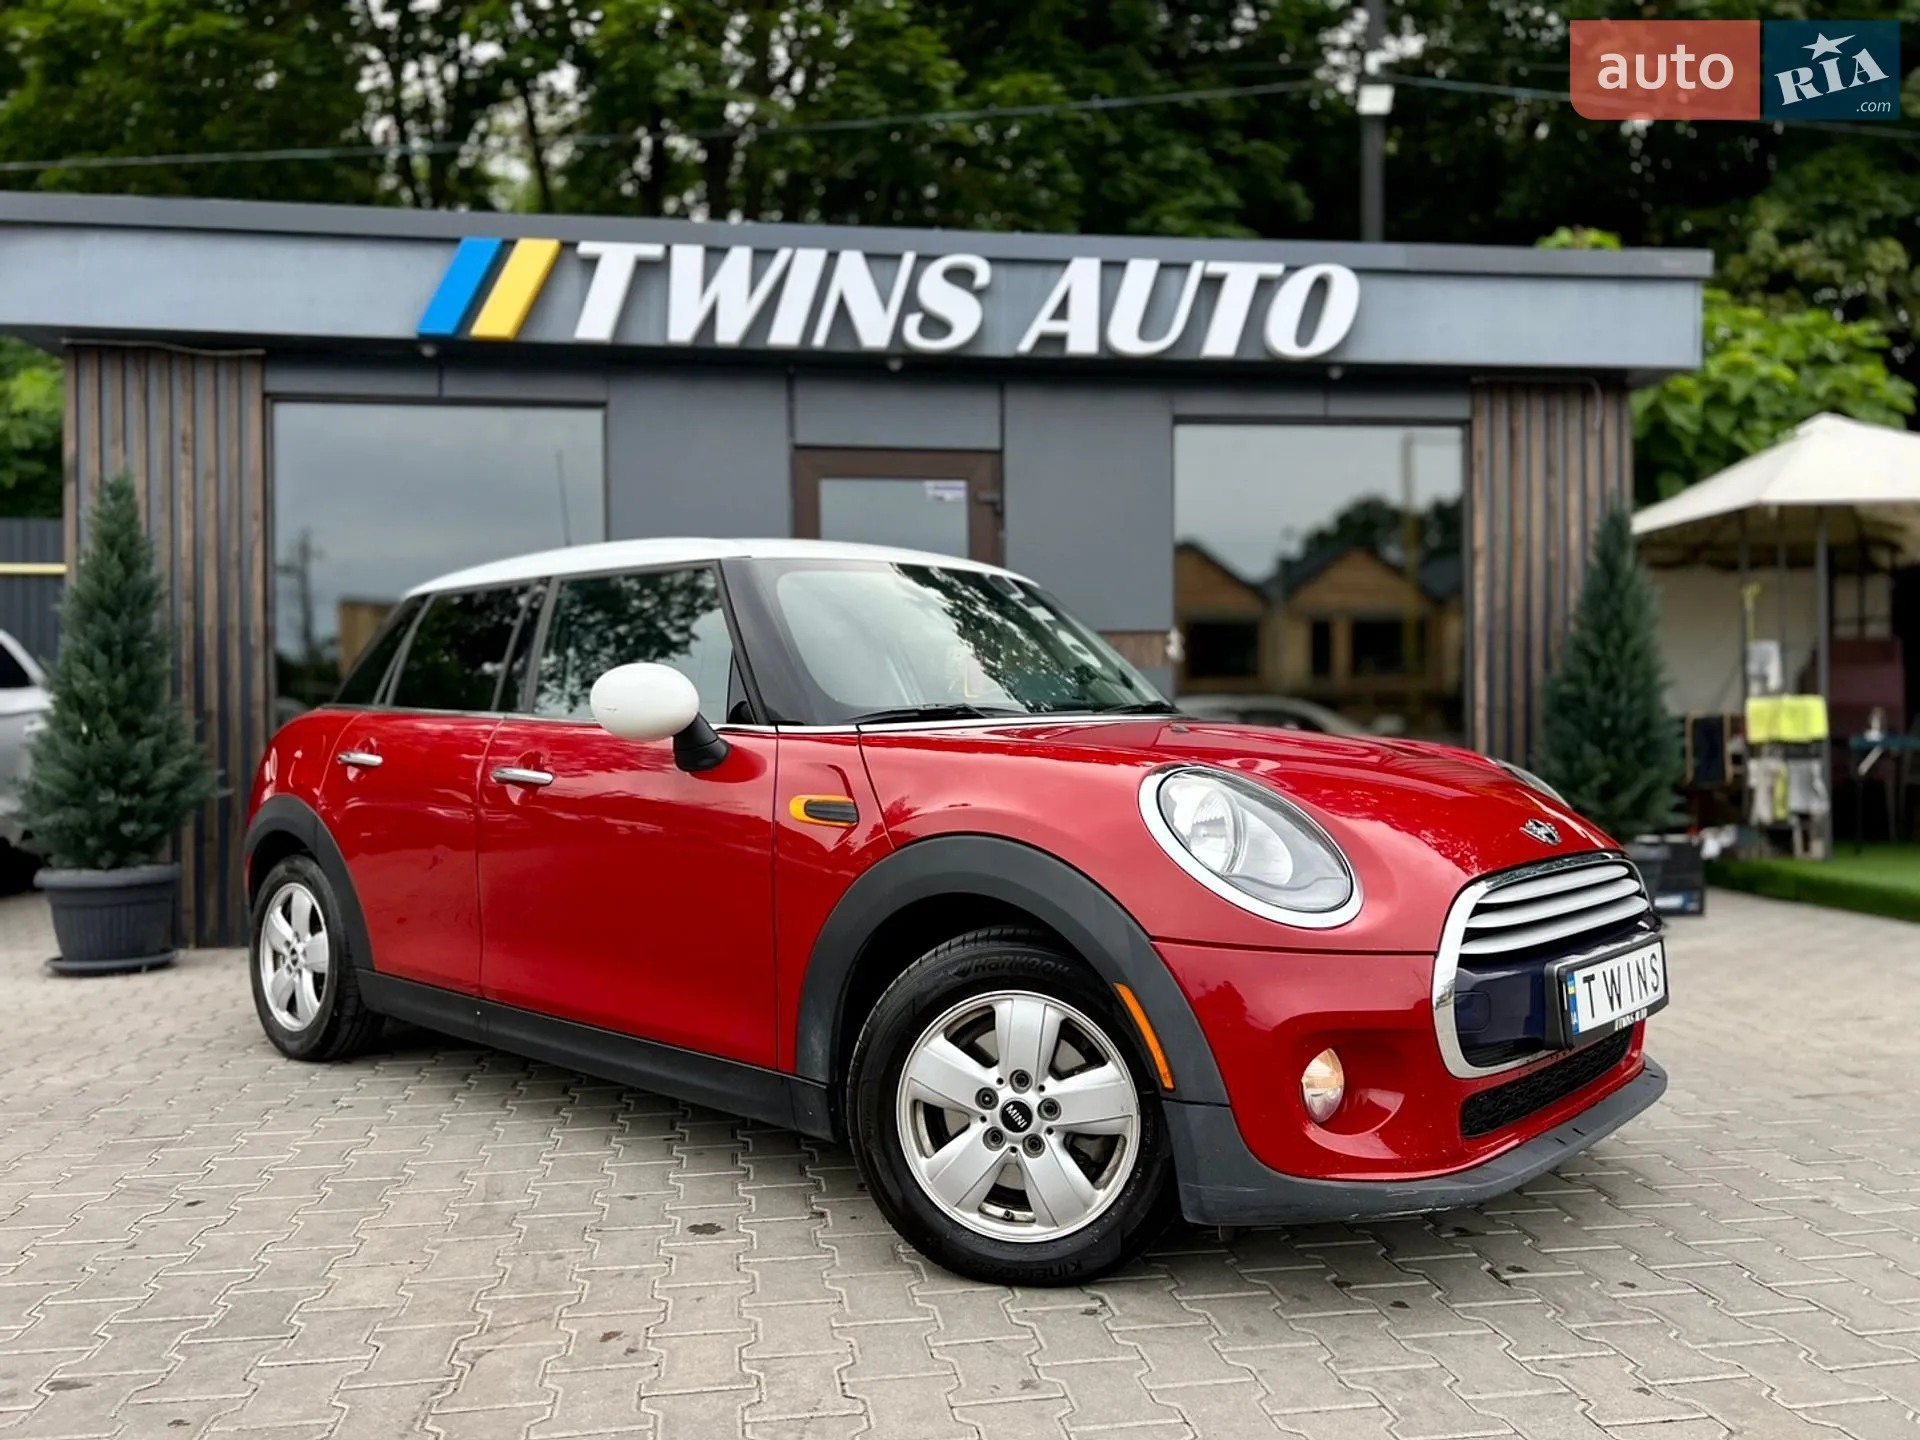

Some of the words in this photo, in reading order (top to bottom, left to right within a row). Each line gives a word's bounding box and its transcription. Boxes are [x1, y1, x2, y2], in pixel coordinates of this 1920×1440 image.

[573, 240, 992, 352] TWINS
[1016, 256, 1361, 359] AUTO
[1582, 952, 1660, 1019] TWINS
[1005, 1103, 1028, 1128] MINI
